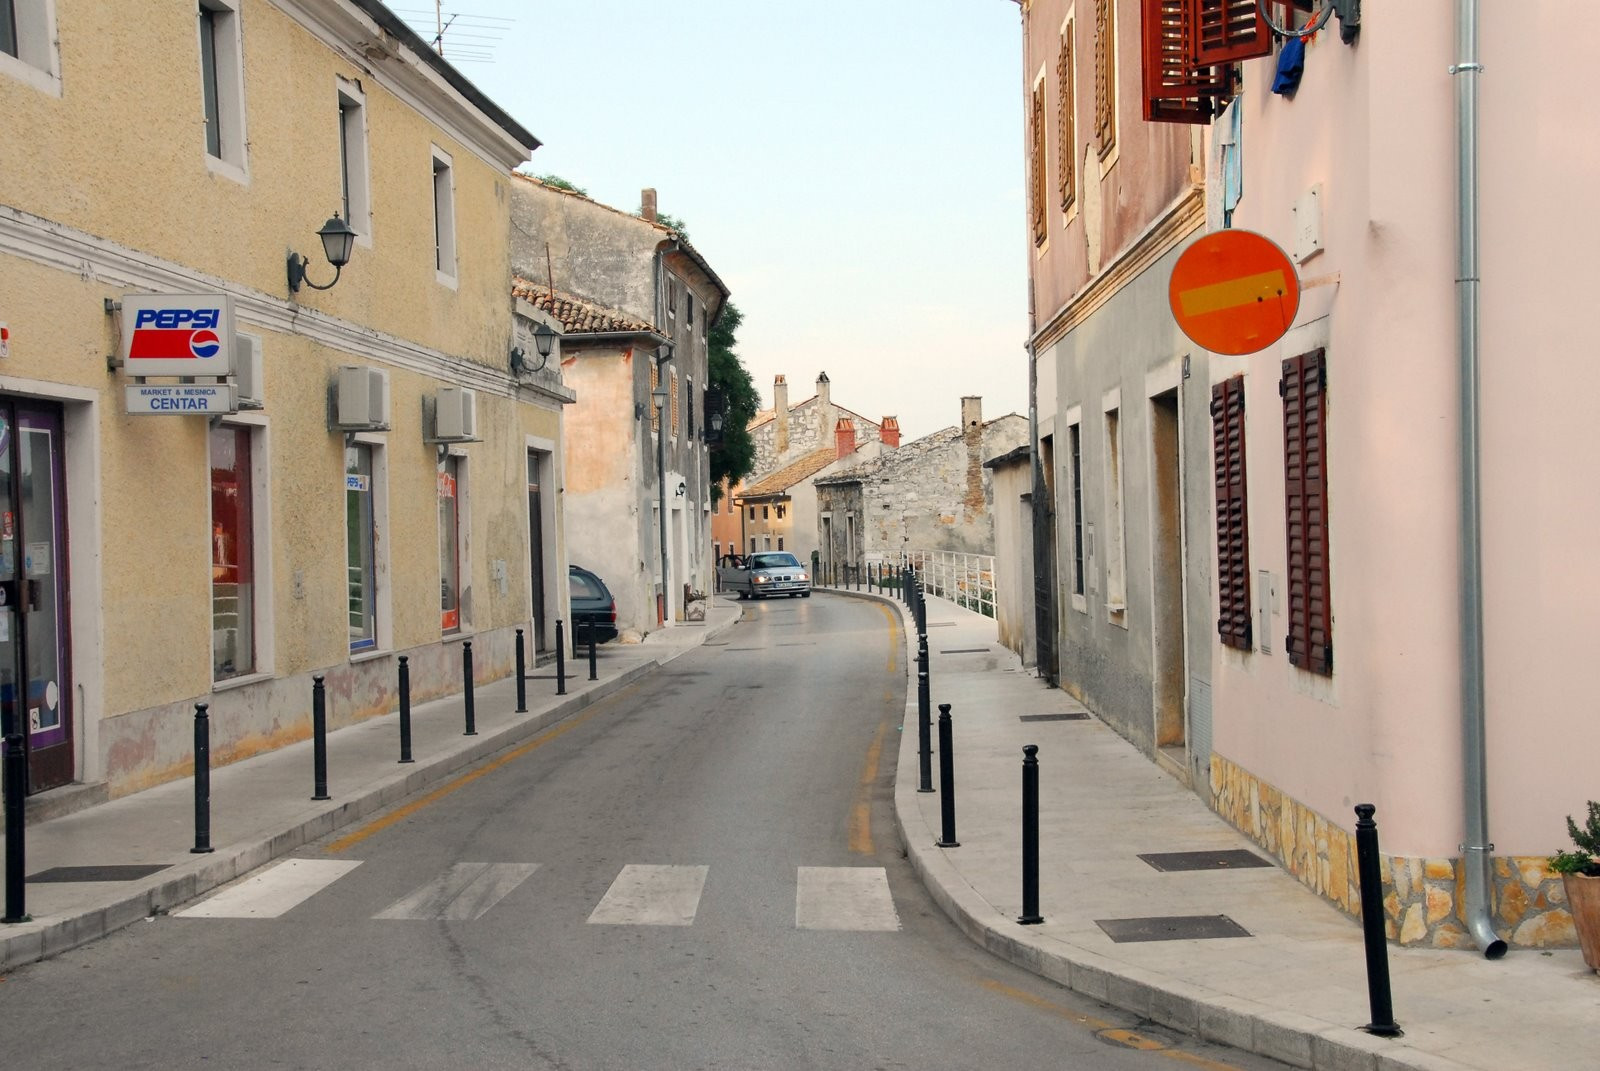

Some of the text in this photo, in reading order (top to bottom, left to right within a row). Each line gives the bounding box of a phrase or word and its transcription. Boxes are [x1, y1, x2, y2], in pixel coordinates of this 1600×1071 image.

[135, 309, 220, 329] PEPSI
[140, 388, 217, 396] MARKET & MESNICA
[150, 397, 208, 410] CENTAR
